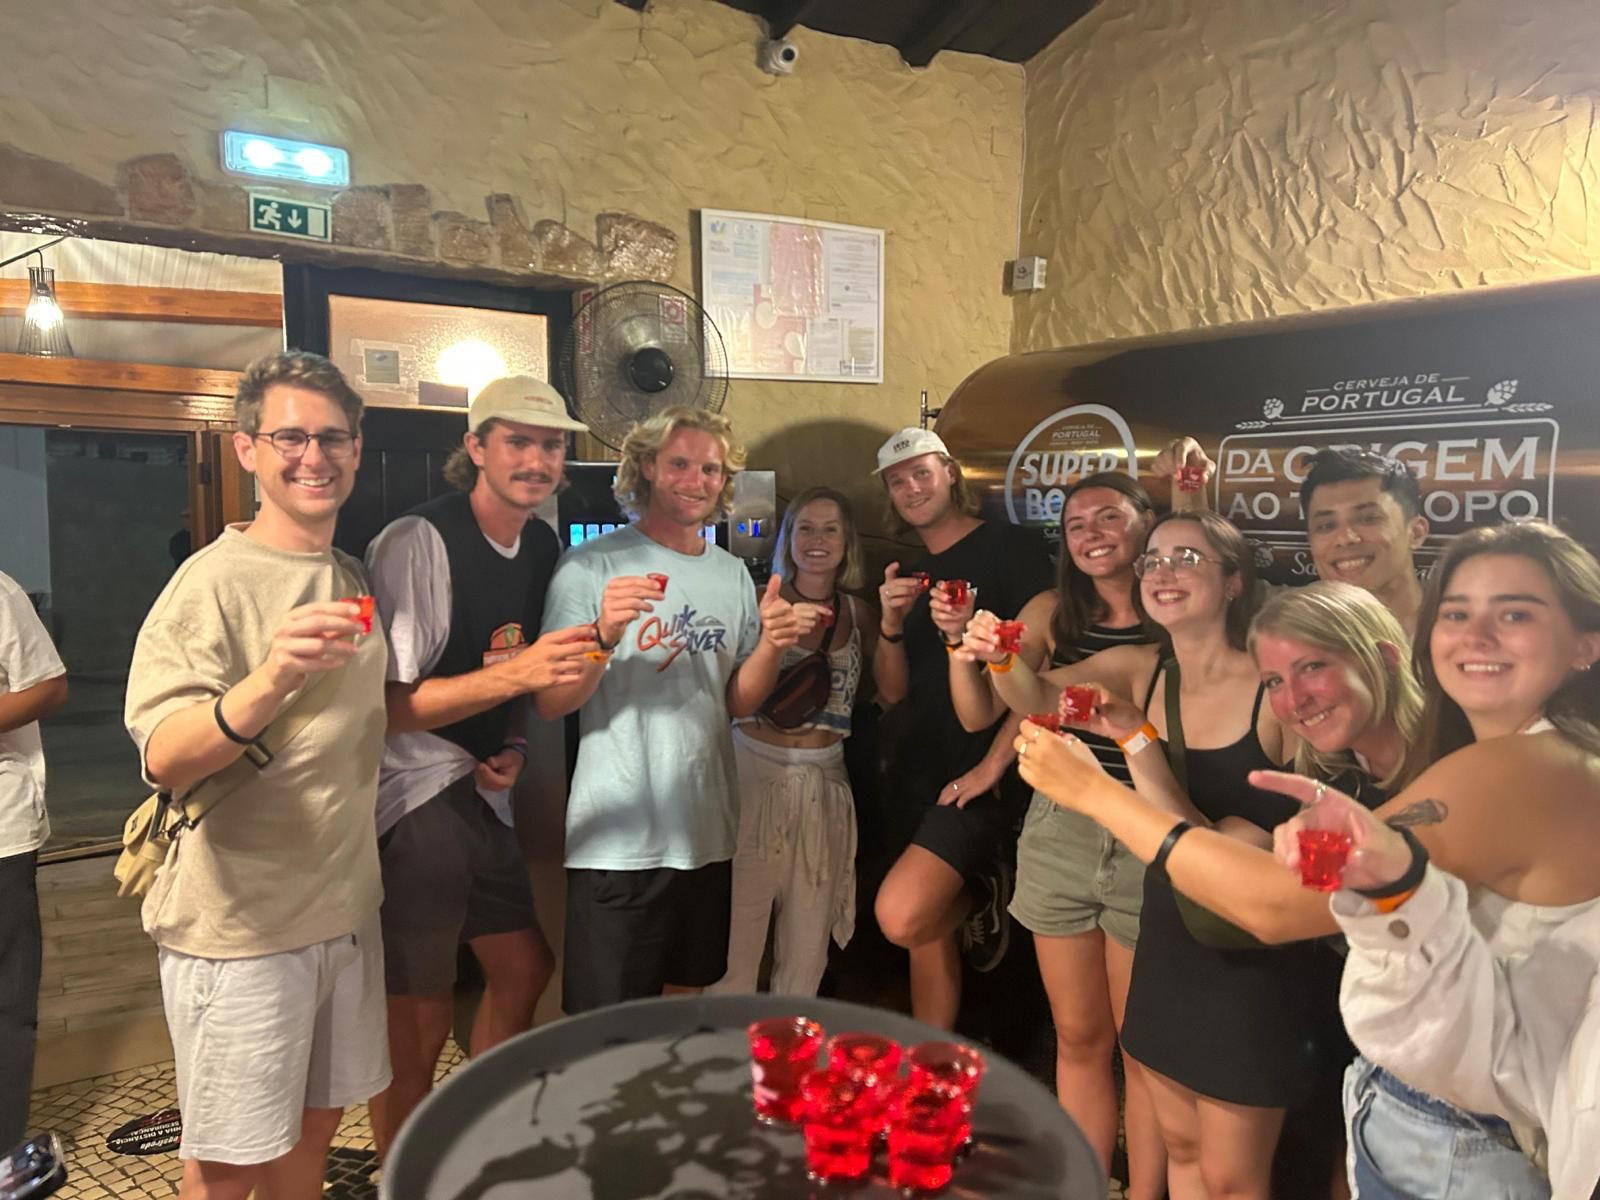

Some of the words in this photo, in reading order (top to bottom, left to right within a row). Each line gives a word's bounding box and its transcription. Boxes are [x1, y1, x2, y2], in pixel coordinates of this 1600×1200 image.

[1333, 375, 1409, 391] CERVEJA
[1414, 373, 1440, 385] DE
[1301, 385, 1465, 412] PORTUGAL
[1052, 430, 1101, 439] PORTUGAL
[1226, 449, 1275, 475] DA
[1283, 436, 1540, 483] OGEM
[1026, 487, 1066, 520] BO
[1227, 491, 1280, 520] AO
